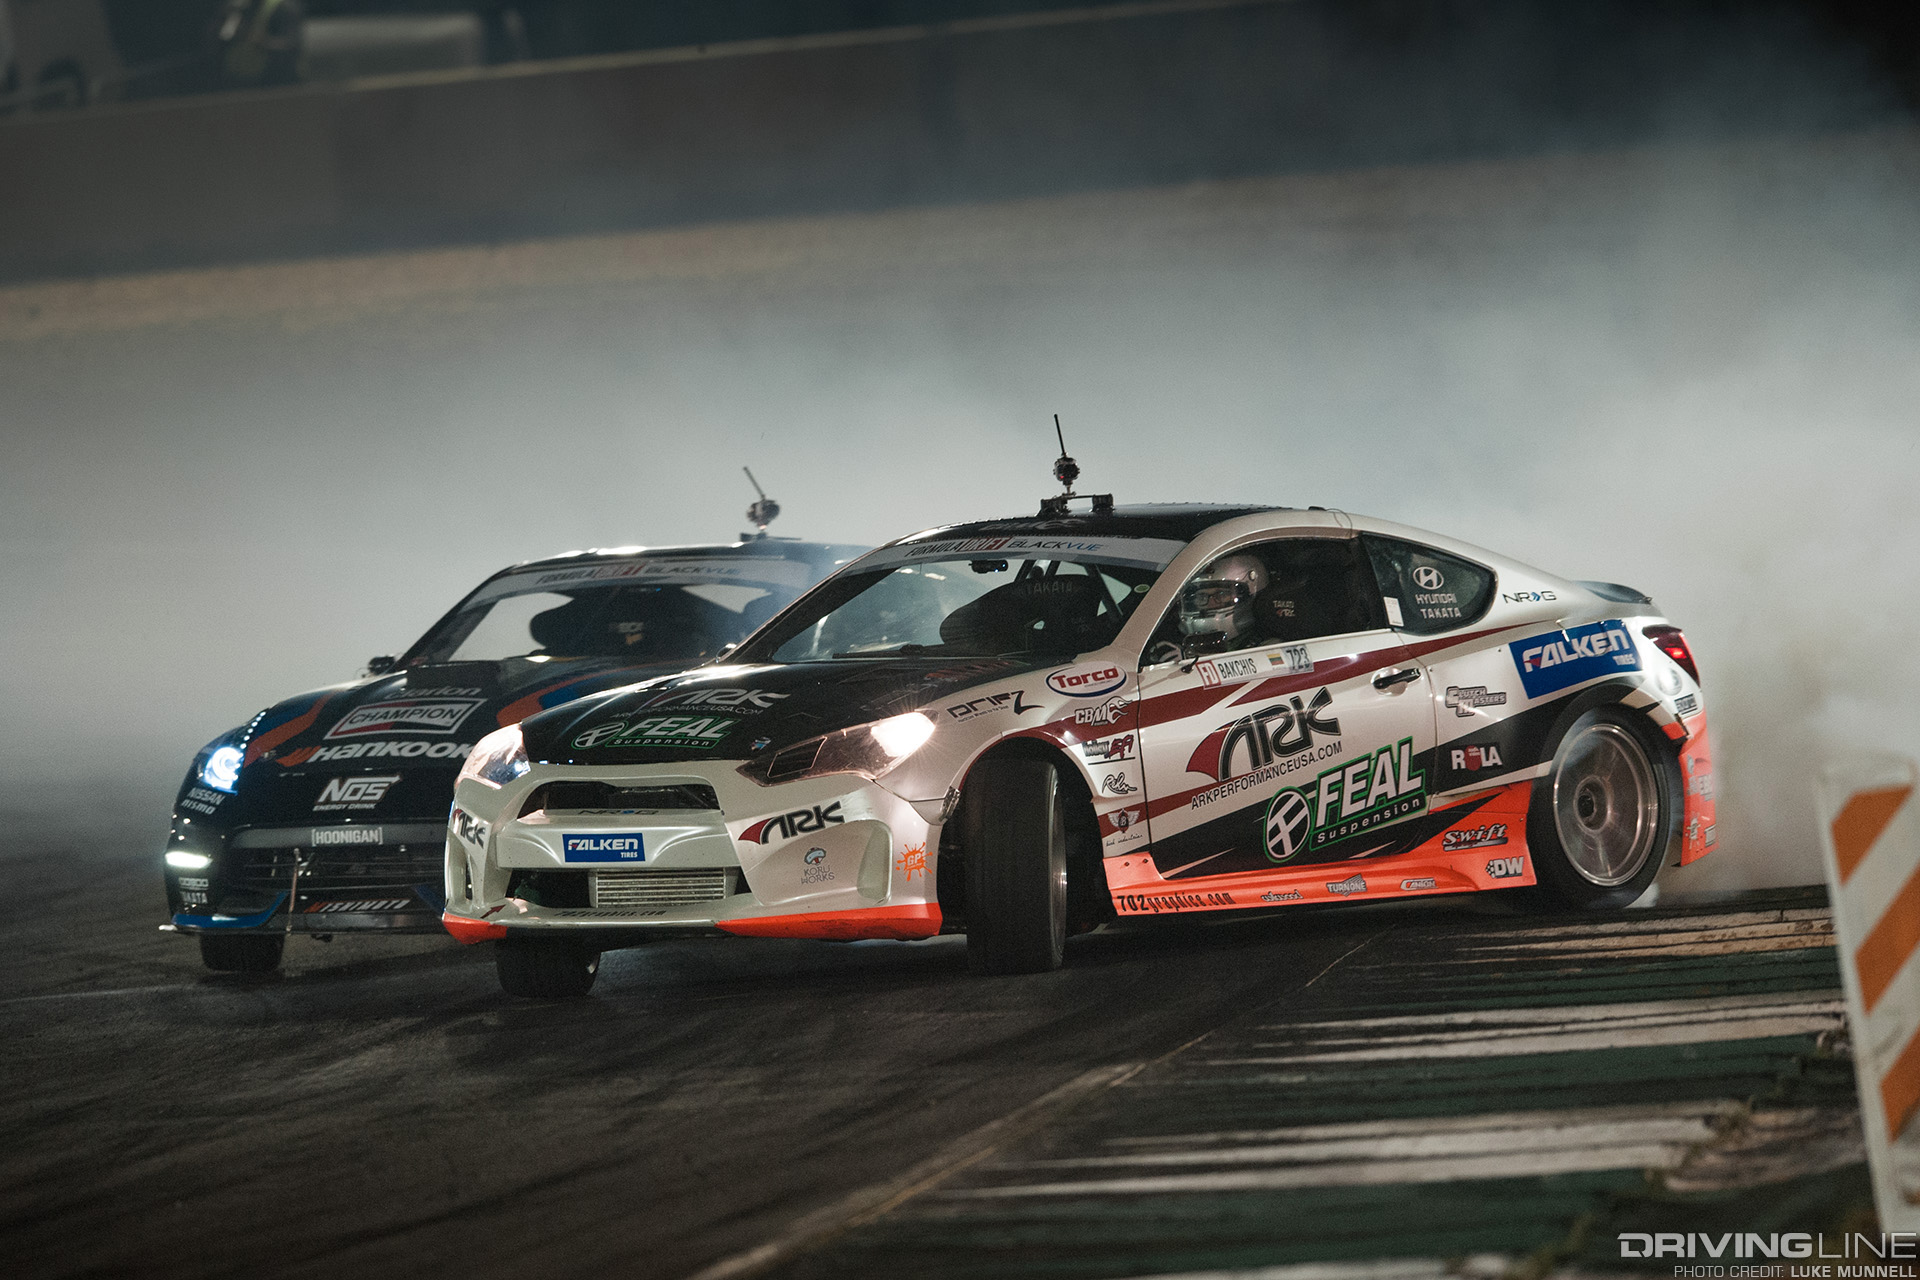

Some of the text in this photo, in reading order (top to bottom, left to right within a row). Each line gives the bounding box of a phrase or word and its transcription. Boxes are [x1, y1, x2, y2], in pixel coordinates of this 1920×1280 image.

[1007, 538, 1103, 551] BLACKVUE
[1415, 593, 1458, 605] HYUNDAI
[1420, 607, 1463, 619] TAKATA
[1285, 647, 1310, 671] 723
[1522, 629, 1631, 673] FALKEN
[1051, 666, 1120, 689] Torco
[1202, 658, 1258, 685] FD BAKCHIS
[349, 707, 464, 725] CHAMPION
[619, 717, 735, 738] FEAL
[613, 738, 710, 747] Suspension
[1190, 741, 1343, 811] ARKPERFORMANCEUSA.COM
[1315, 741, 1423, 828] FEAL
[187, 787, 226, 806] NISSAN
[316, 775, 401, 802] NOS
[312, 804, 346, 812] ENERGY
[1317, 798, 1421, 844] Suspension
[568, 838, 639, 851] FALKEN
[1442, 823, 1508, 845] Swift
[907, 852, 922, 867] GP
[1493, 856, 1525, 877] DW
[801, 873, 836, 885] WORKS
[803, 865, 831, 877] KORU
[1117, 892, 1237, 913] 702graphics.com
